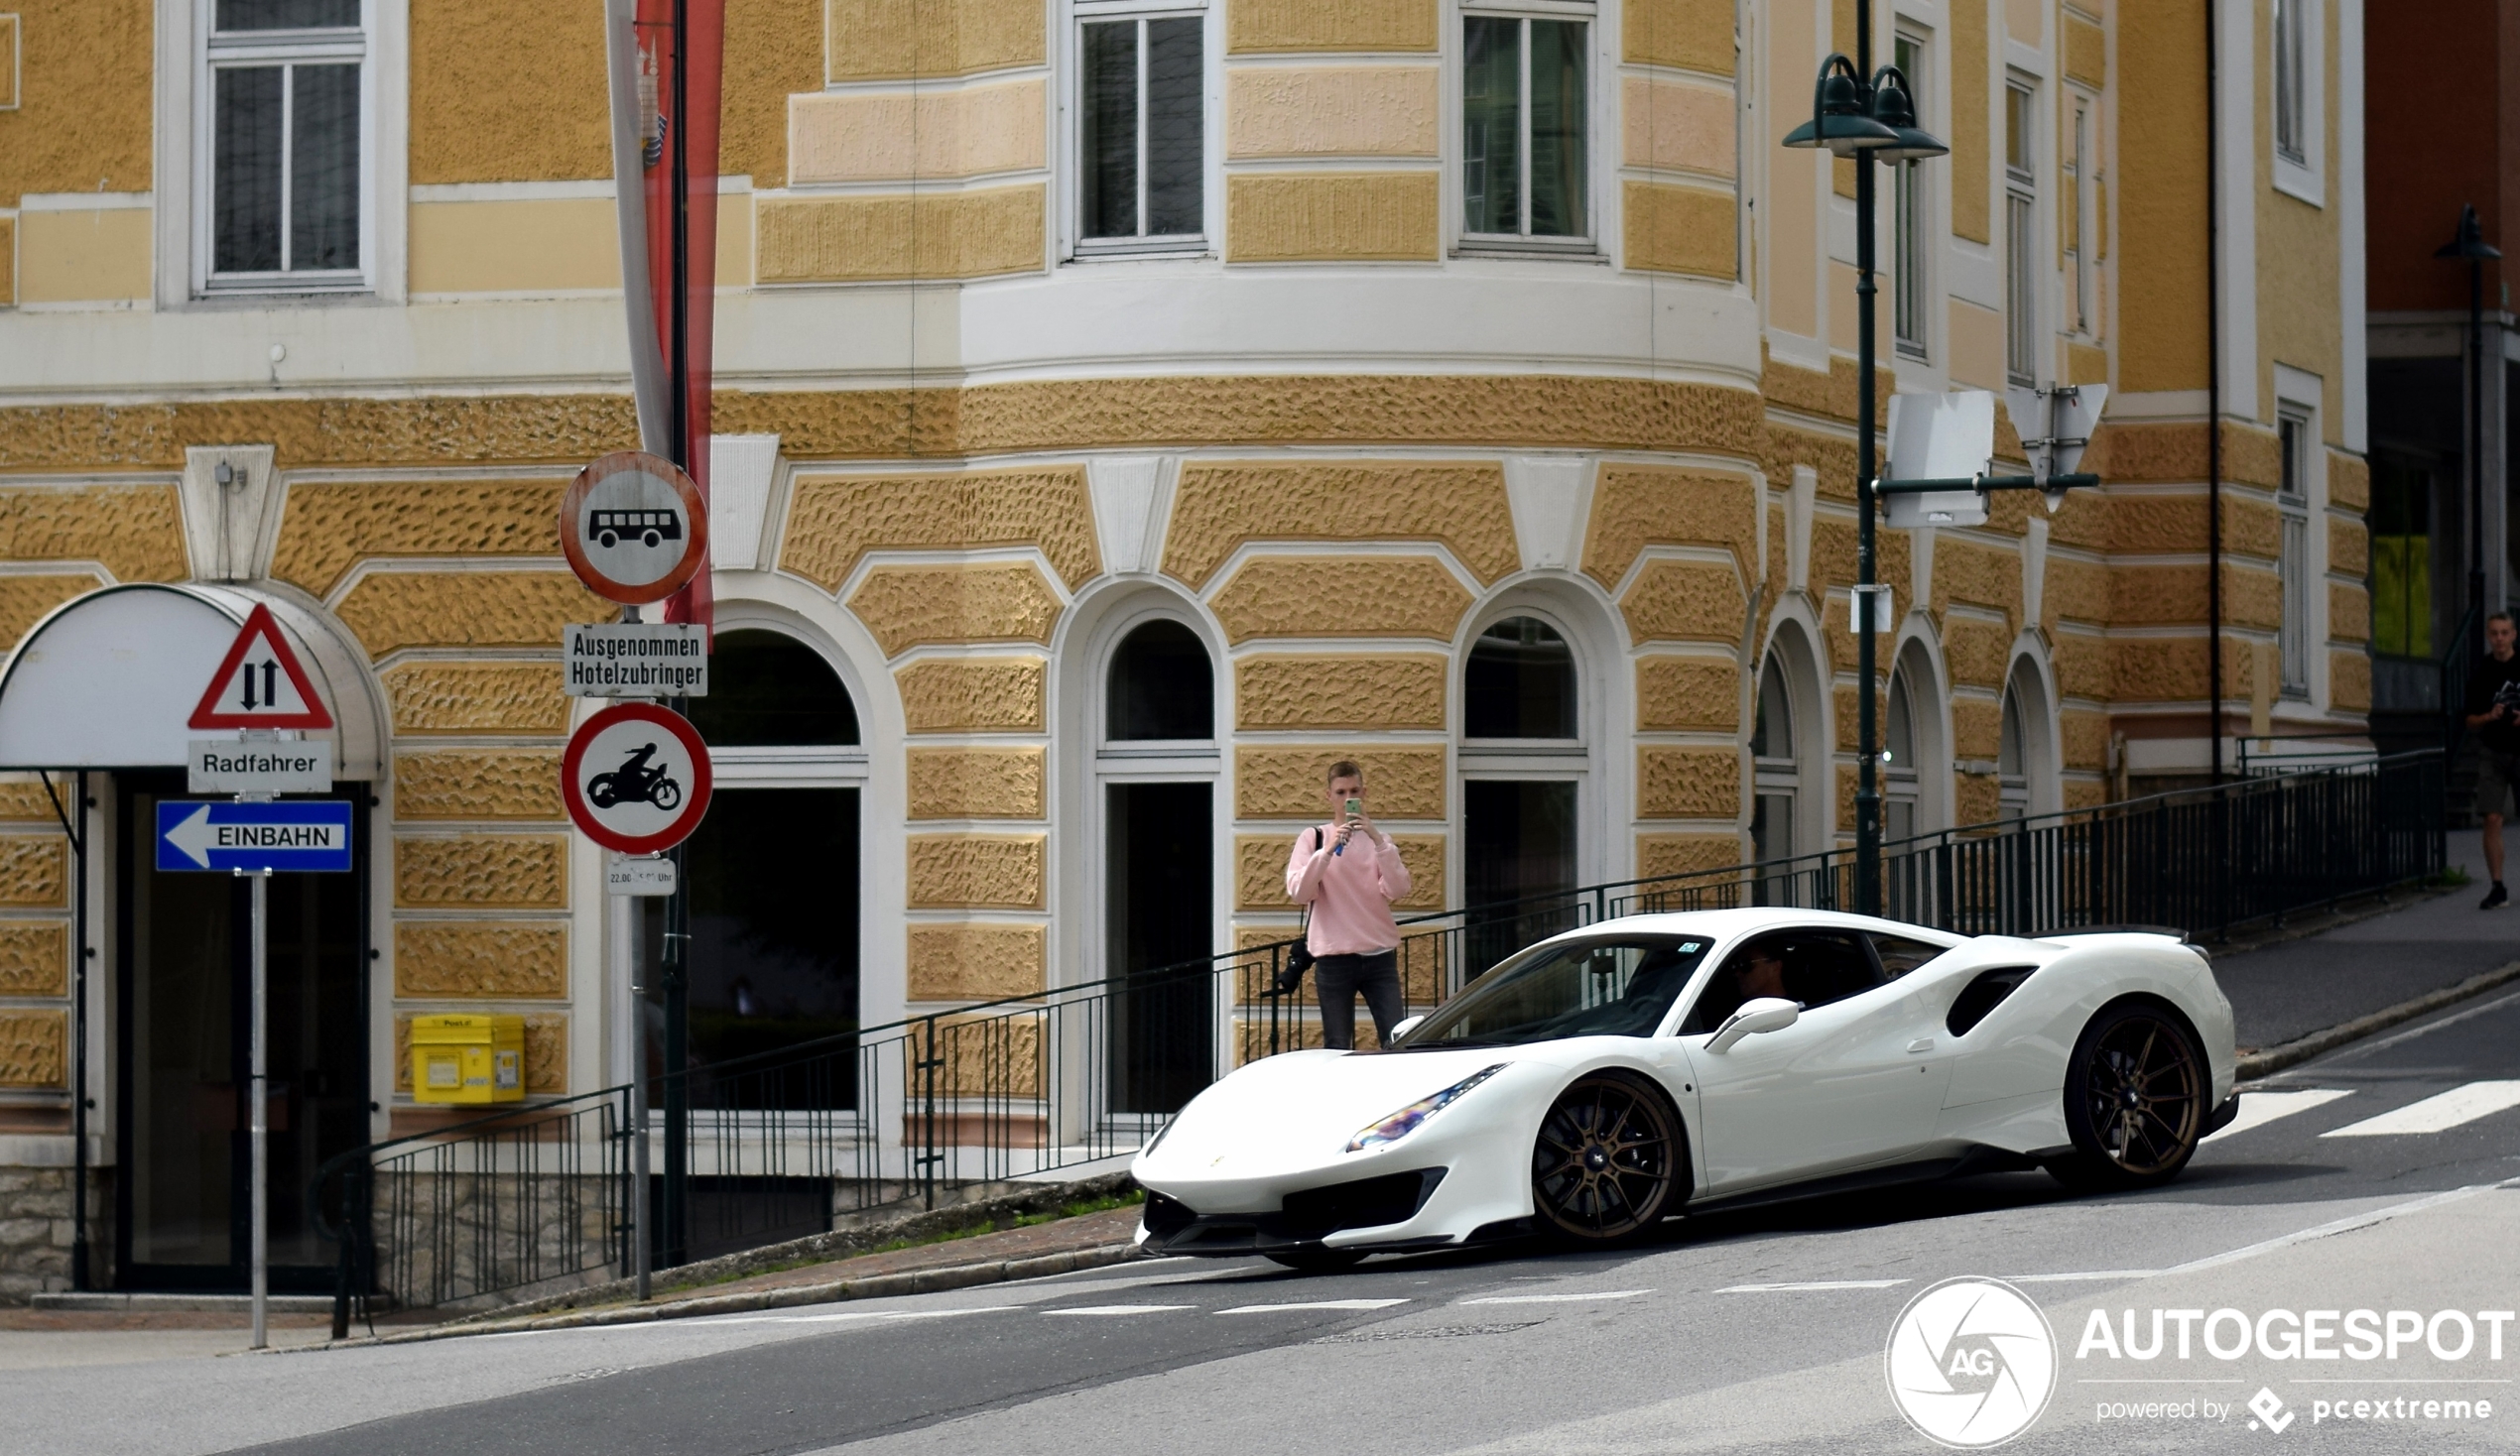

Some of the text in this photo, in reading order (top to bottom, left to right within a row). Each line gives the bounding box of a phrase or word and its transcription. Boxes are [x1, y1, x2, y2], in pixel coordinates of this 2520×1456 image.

[573, 633, 699, 660] Ausgenommen
[572, 662, 702, 688] Hotelzubringer
[203, 754, 317, 773] Radfahrer
[218, 827, 329, 846] EINBAHN
[658, 873, 673, 882] Uhr
